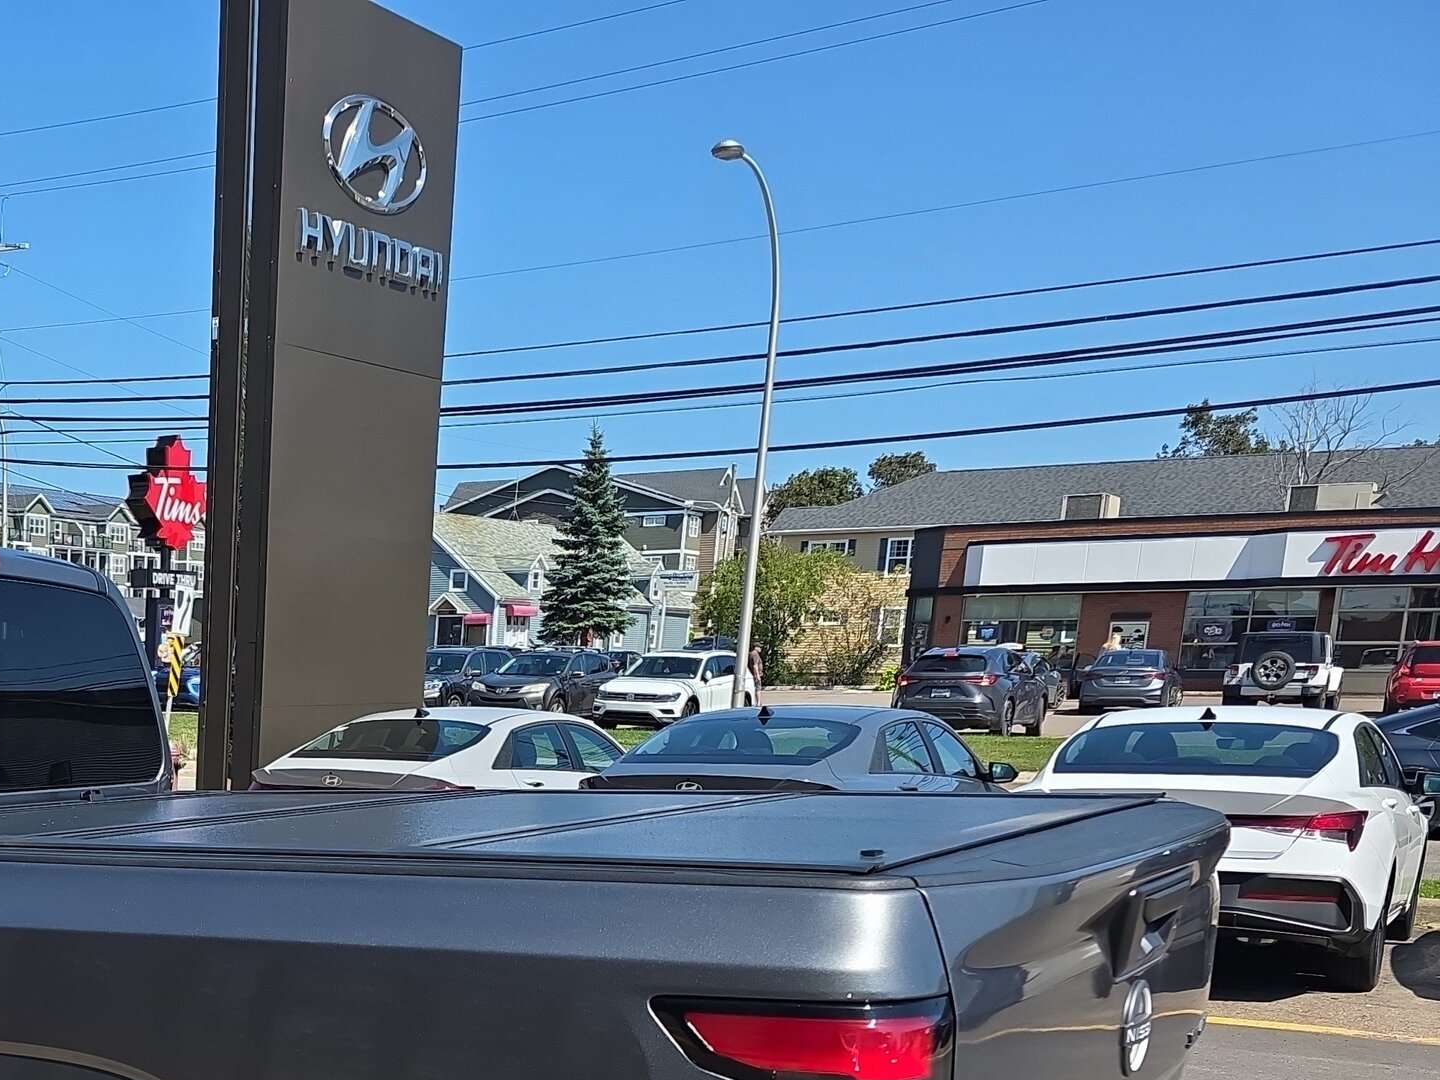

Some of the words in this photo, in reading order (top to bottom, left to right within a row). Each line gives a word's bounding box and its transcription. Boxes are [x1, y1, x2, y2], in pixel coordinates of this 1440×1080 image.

[297, 207, 443, 294] HYUNDAI
[154, 476, 201, 525] Tims
[1323, 533, 1398, 575] Tim
[152, 572, 175, 586] DRIVE
[176, 574, 197, 587] THRU
